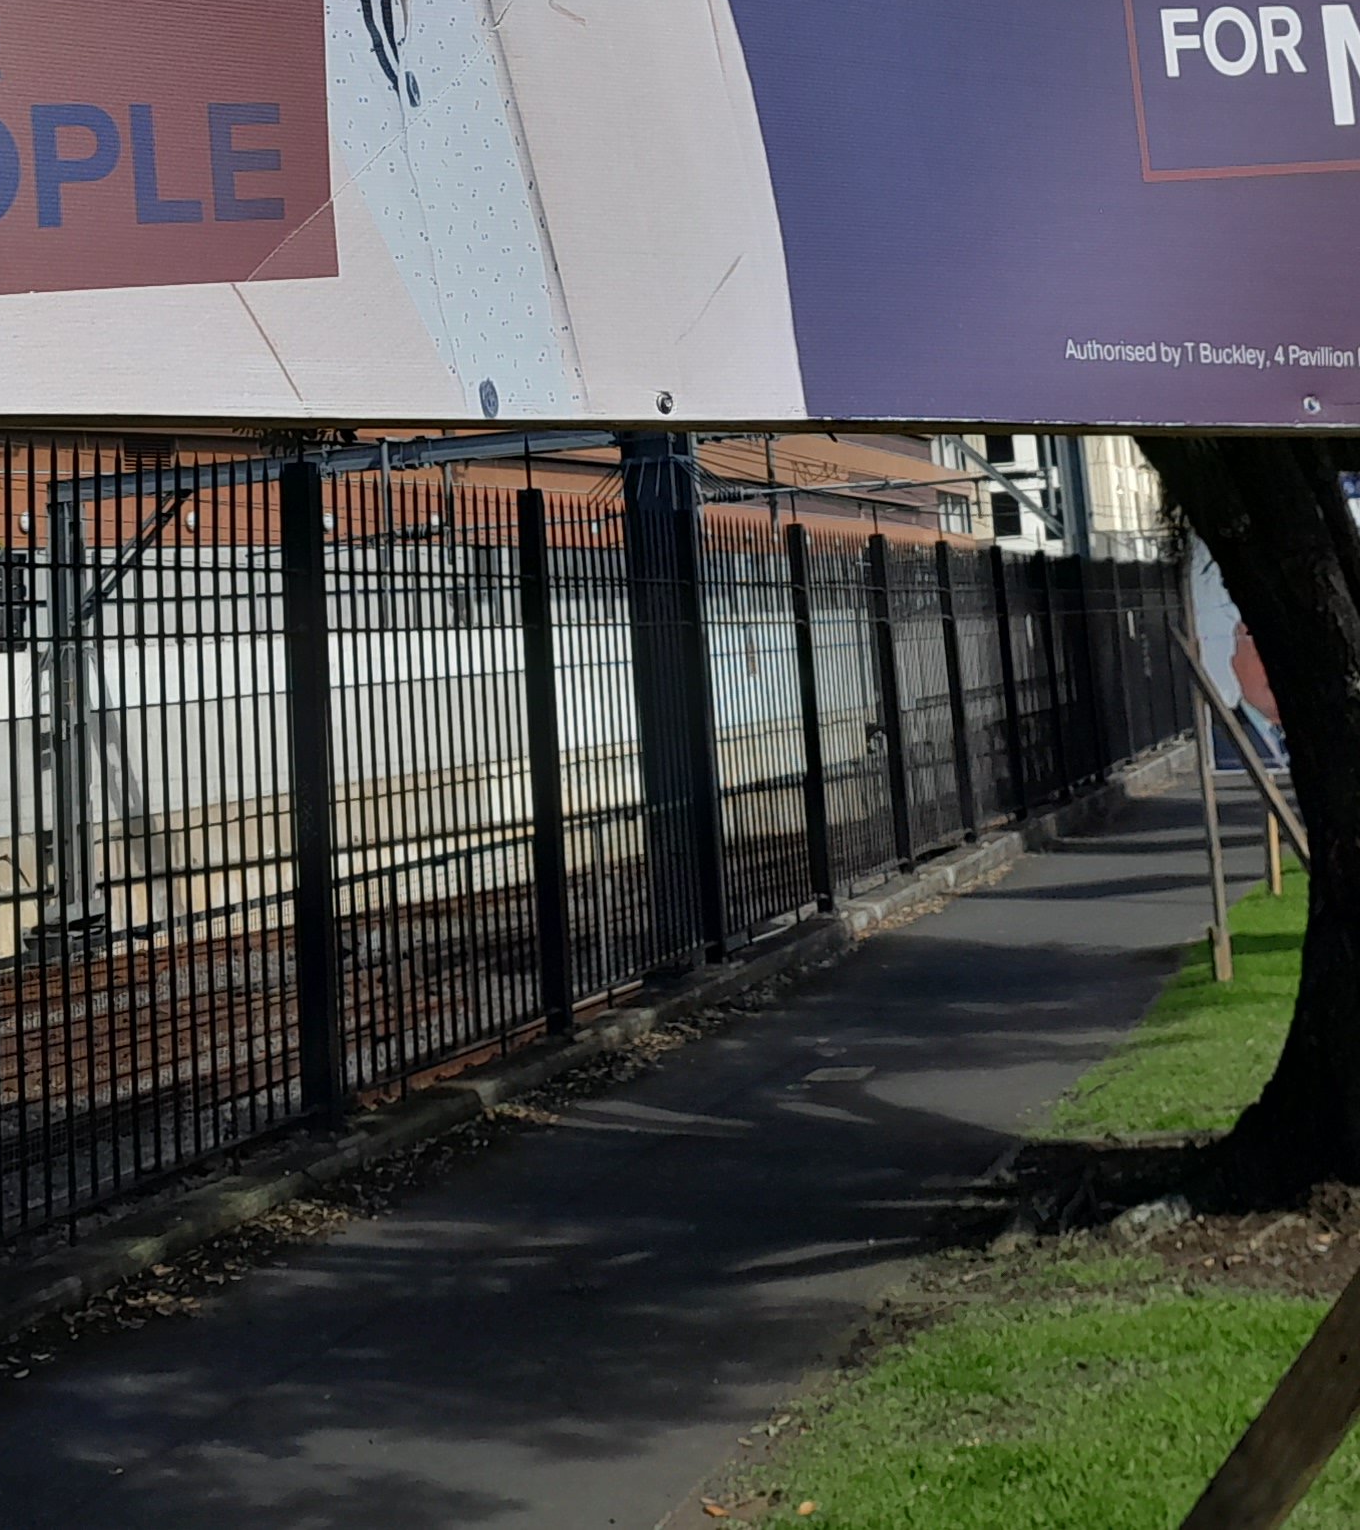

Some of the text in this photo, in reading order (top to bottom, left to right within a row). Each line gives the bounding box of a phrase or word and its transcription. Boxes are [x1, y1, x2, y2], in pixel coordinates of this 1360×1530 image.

[1159, 6, 1308, 78] FOR
[1064, 338, 1157, 363] Authorised
[1159, 341, 1182, 368] by
[1183, 341, 1195, 362] T
[1198, 342, 1271, 369] Buckley,
[1273, 344, 1286, 366] 4
